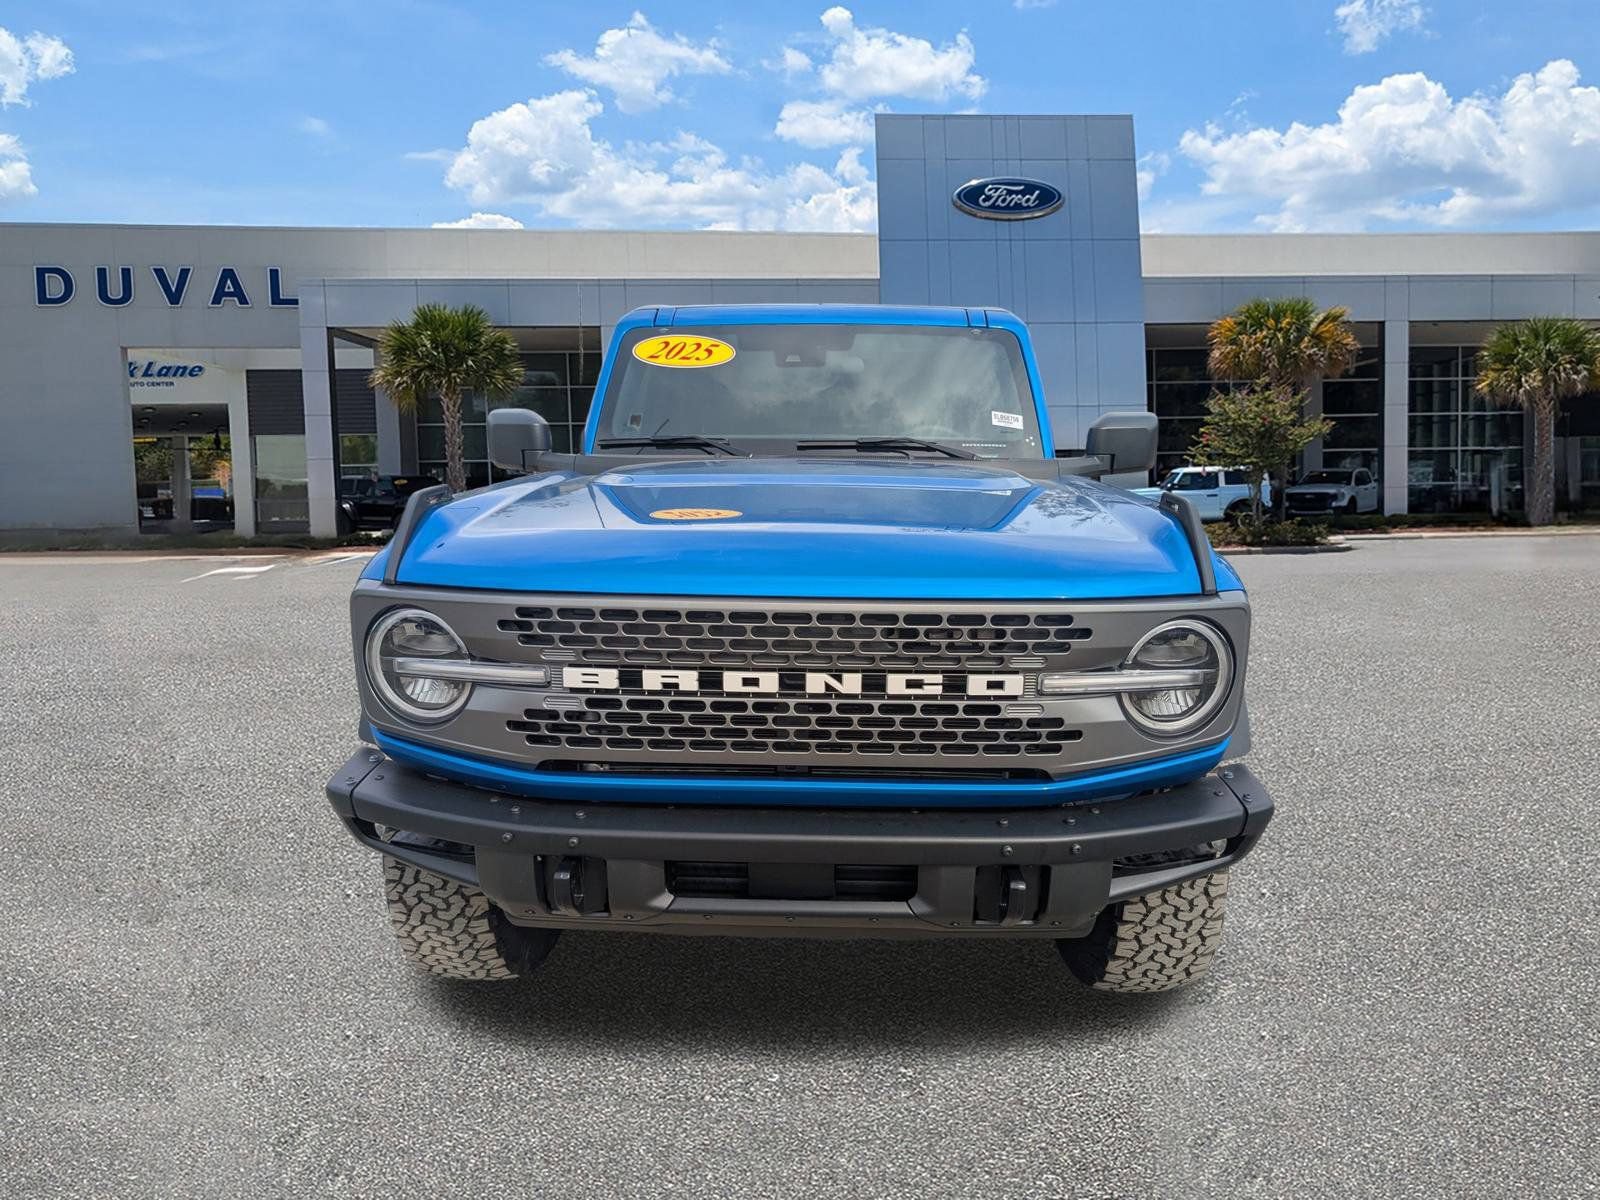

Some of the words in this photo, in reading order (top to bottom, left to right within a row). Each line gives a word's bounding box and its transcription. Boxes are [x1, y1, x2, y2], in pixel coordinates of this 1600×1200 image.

[978, 184, 1041, 208] Ford
[34, 266, 299, 308] DUVAL
[647, 340, 720, 360] 2025
[142, 361, 204, 377] Lane
[563, 666, 1024, 696] BRONCO
